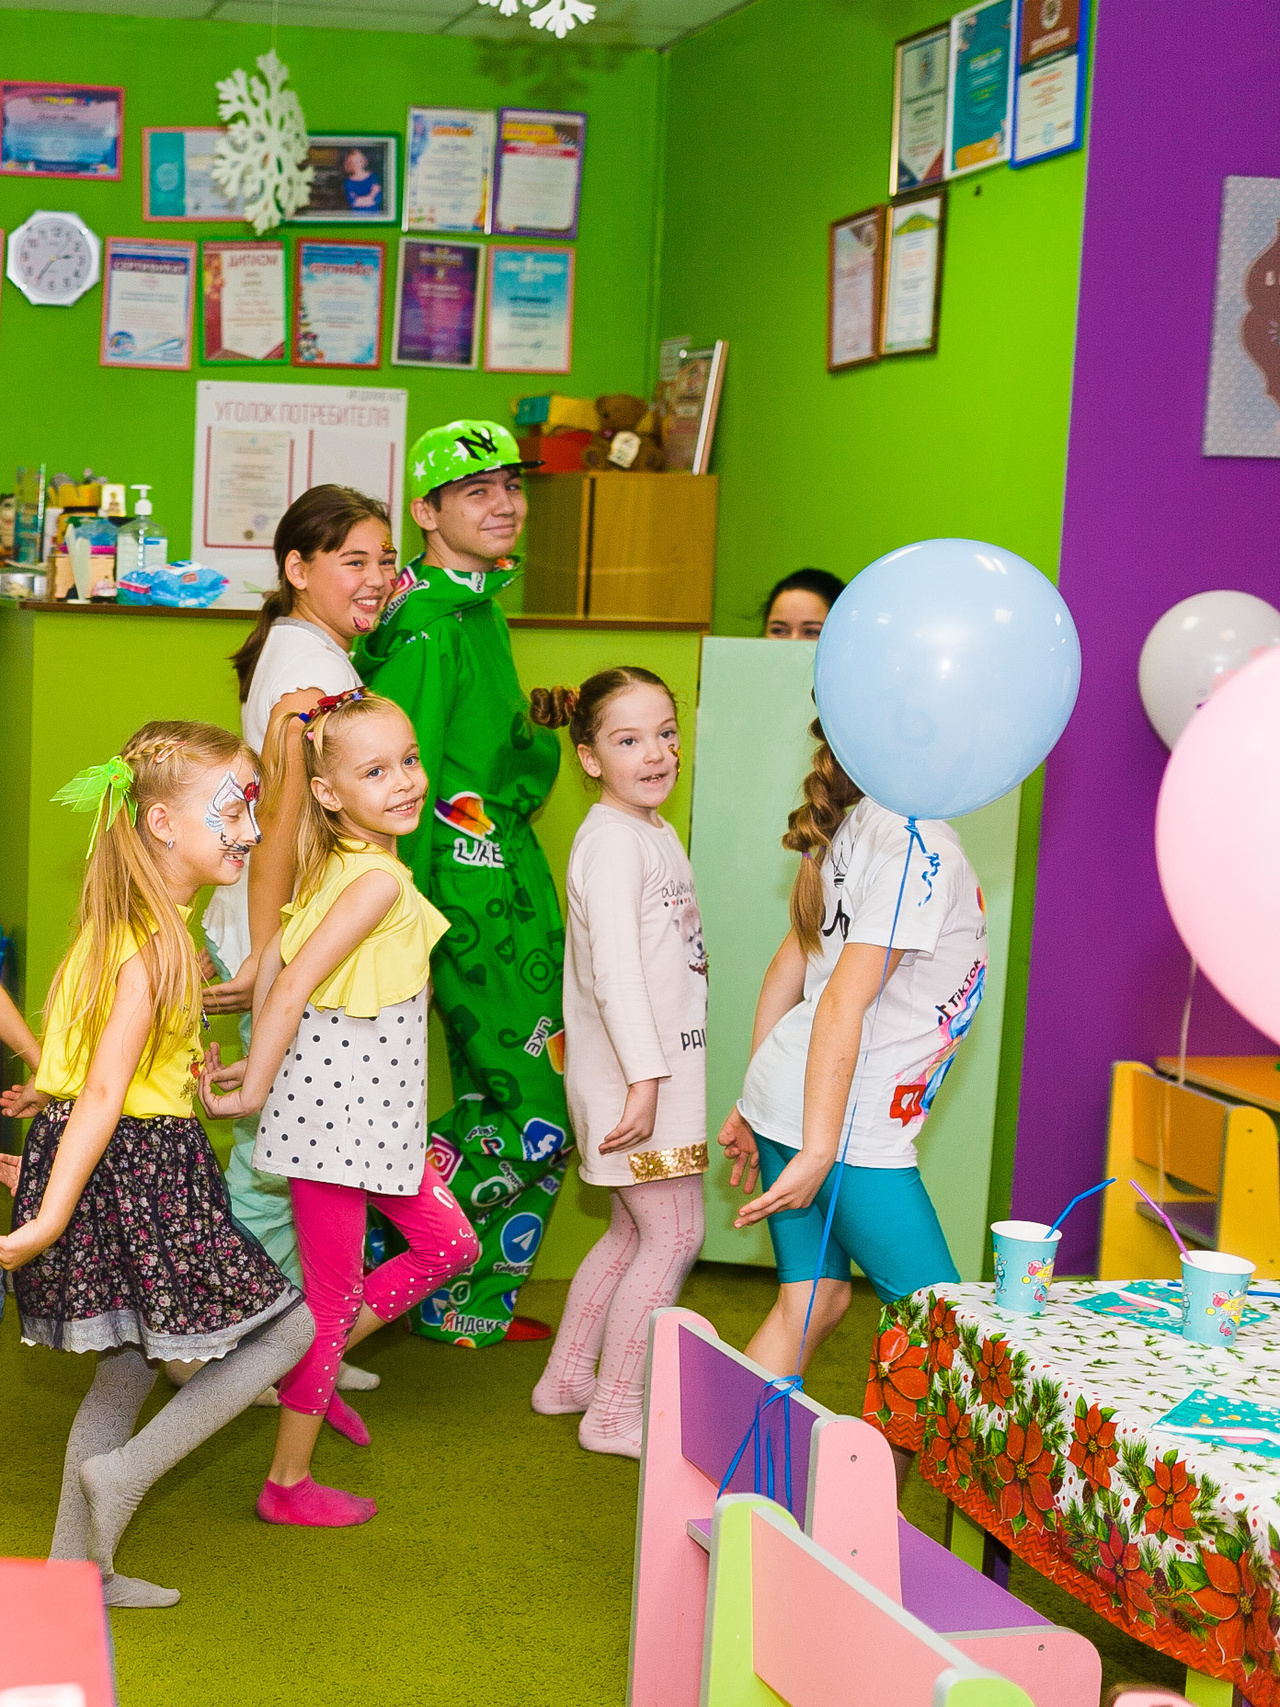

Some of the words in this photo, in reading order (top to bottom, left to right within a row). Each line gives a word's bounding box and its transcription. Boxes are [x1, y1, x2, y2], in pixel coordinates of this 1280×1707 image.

[215, 401, 276, 423] УГОЛОК
[279, 403, 390, 427] ПОТРЕБИТЕЛЯ
[948, 958, 982, 1008] TikTok
[527, 1018, 550, 1055] LIKE
